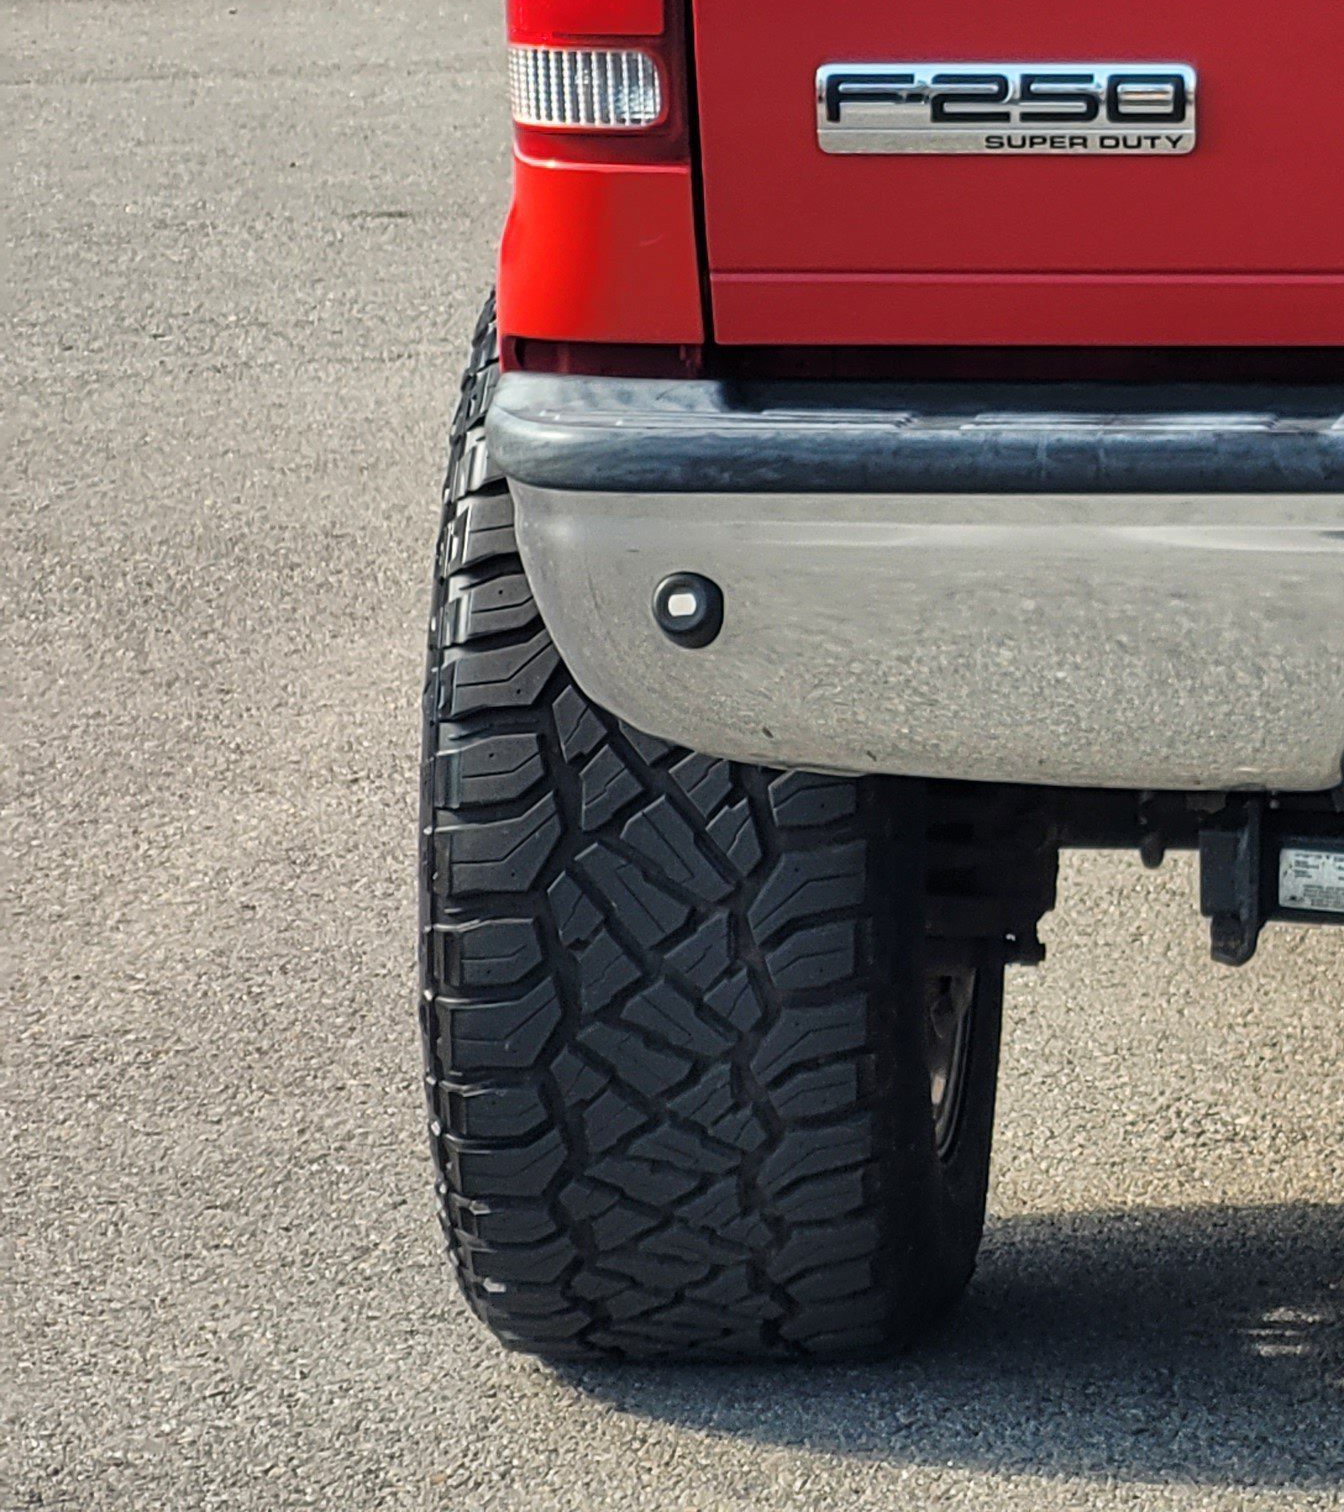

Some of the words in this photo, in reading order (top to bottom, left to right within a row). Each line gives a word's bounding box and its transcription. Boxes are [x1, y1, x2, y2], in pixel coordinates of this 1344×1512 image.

[825, 72, 1186, 123] F-250
[984, 134, 1089, 150] SUPER
[1099, 134, 1184, 150] DUTY
